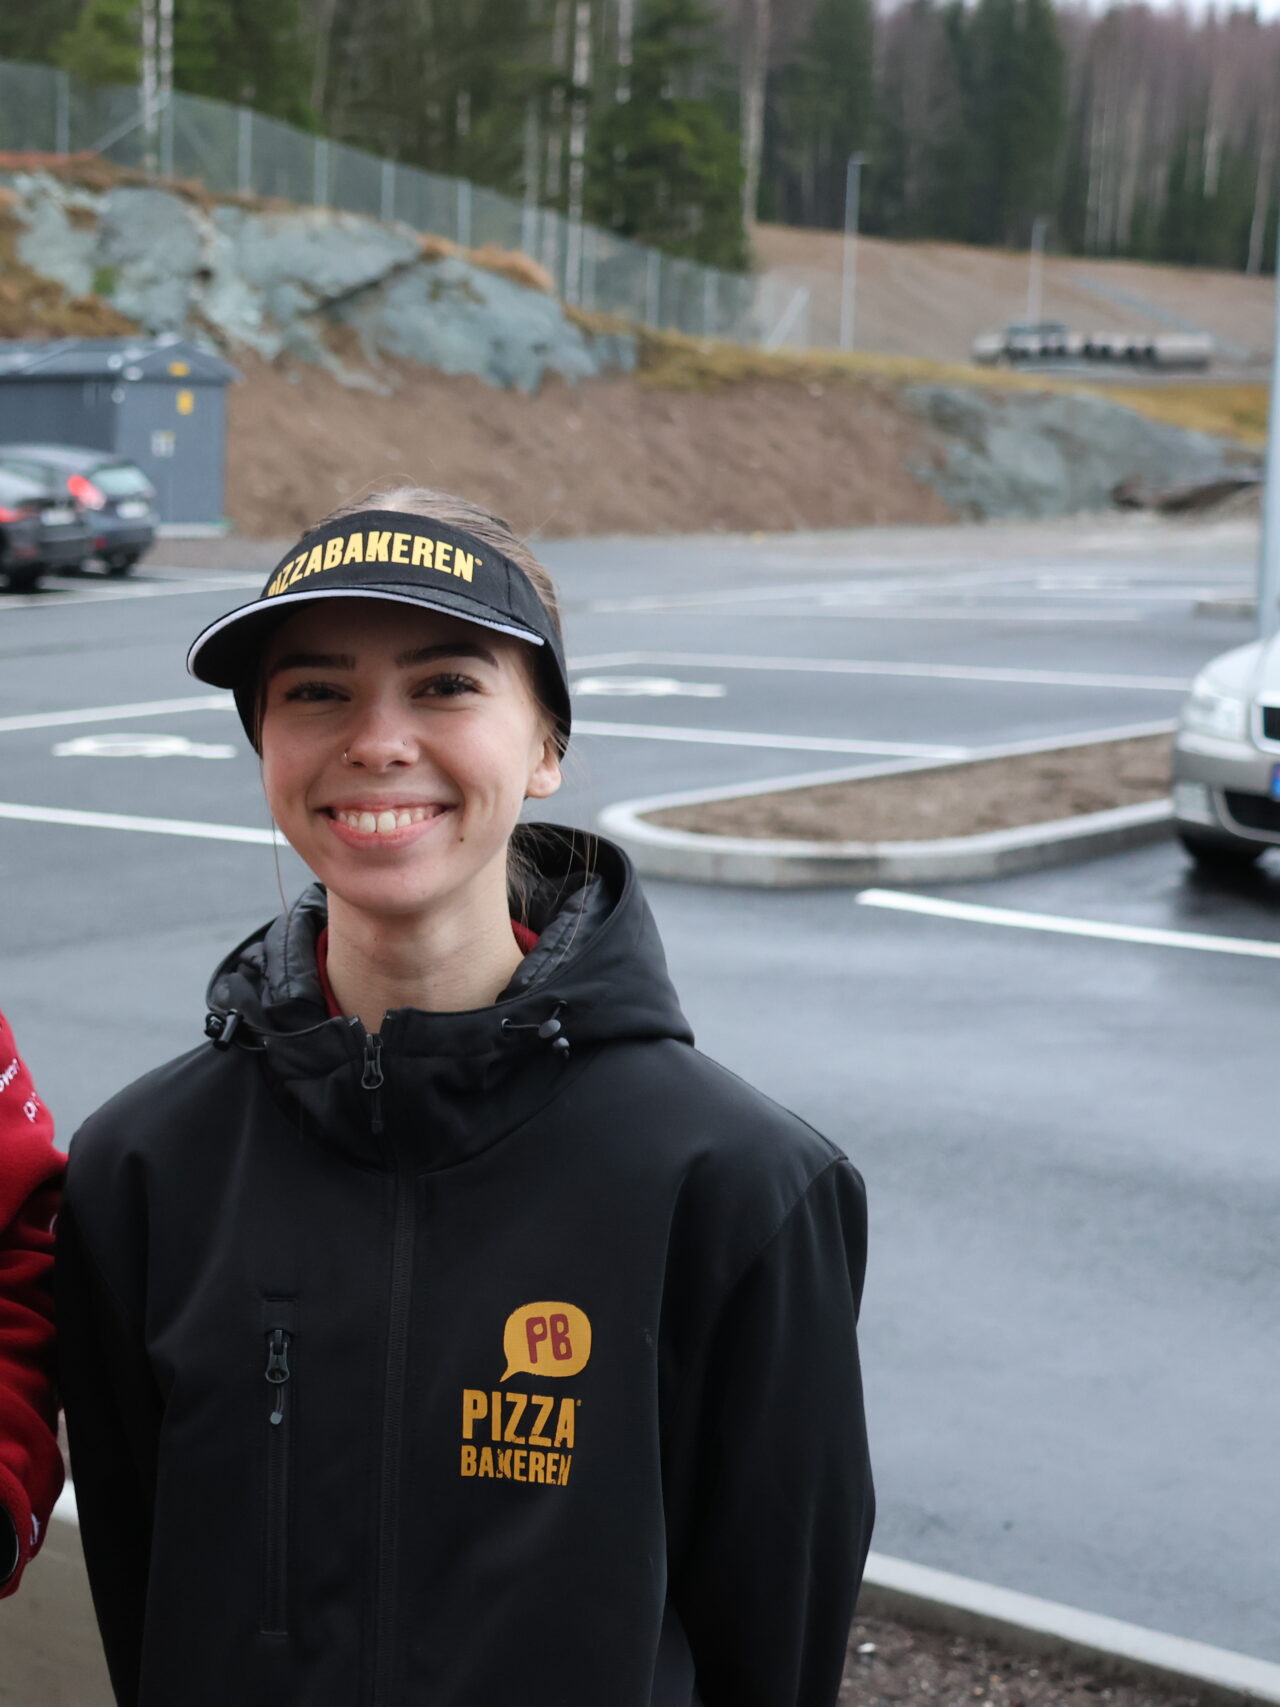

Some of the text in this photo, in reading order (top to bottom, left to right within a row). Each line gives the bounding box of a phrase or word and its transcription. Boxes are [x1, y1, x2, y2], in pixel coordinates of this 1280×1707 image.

[525, 1313, 573, 1365] PB
[462, 1388, 575, 1449] PIZZA
[460, 1445, 572, 1487] BAKEREN
